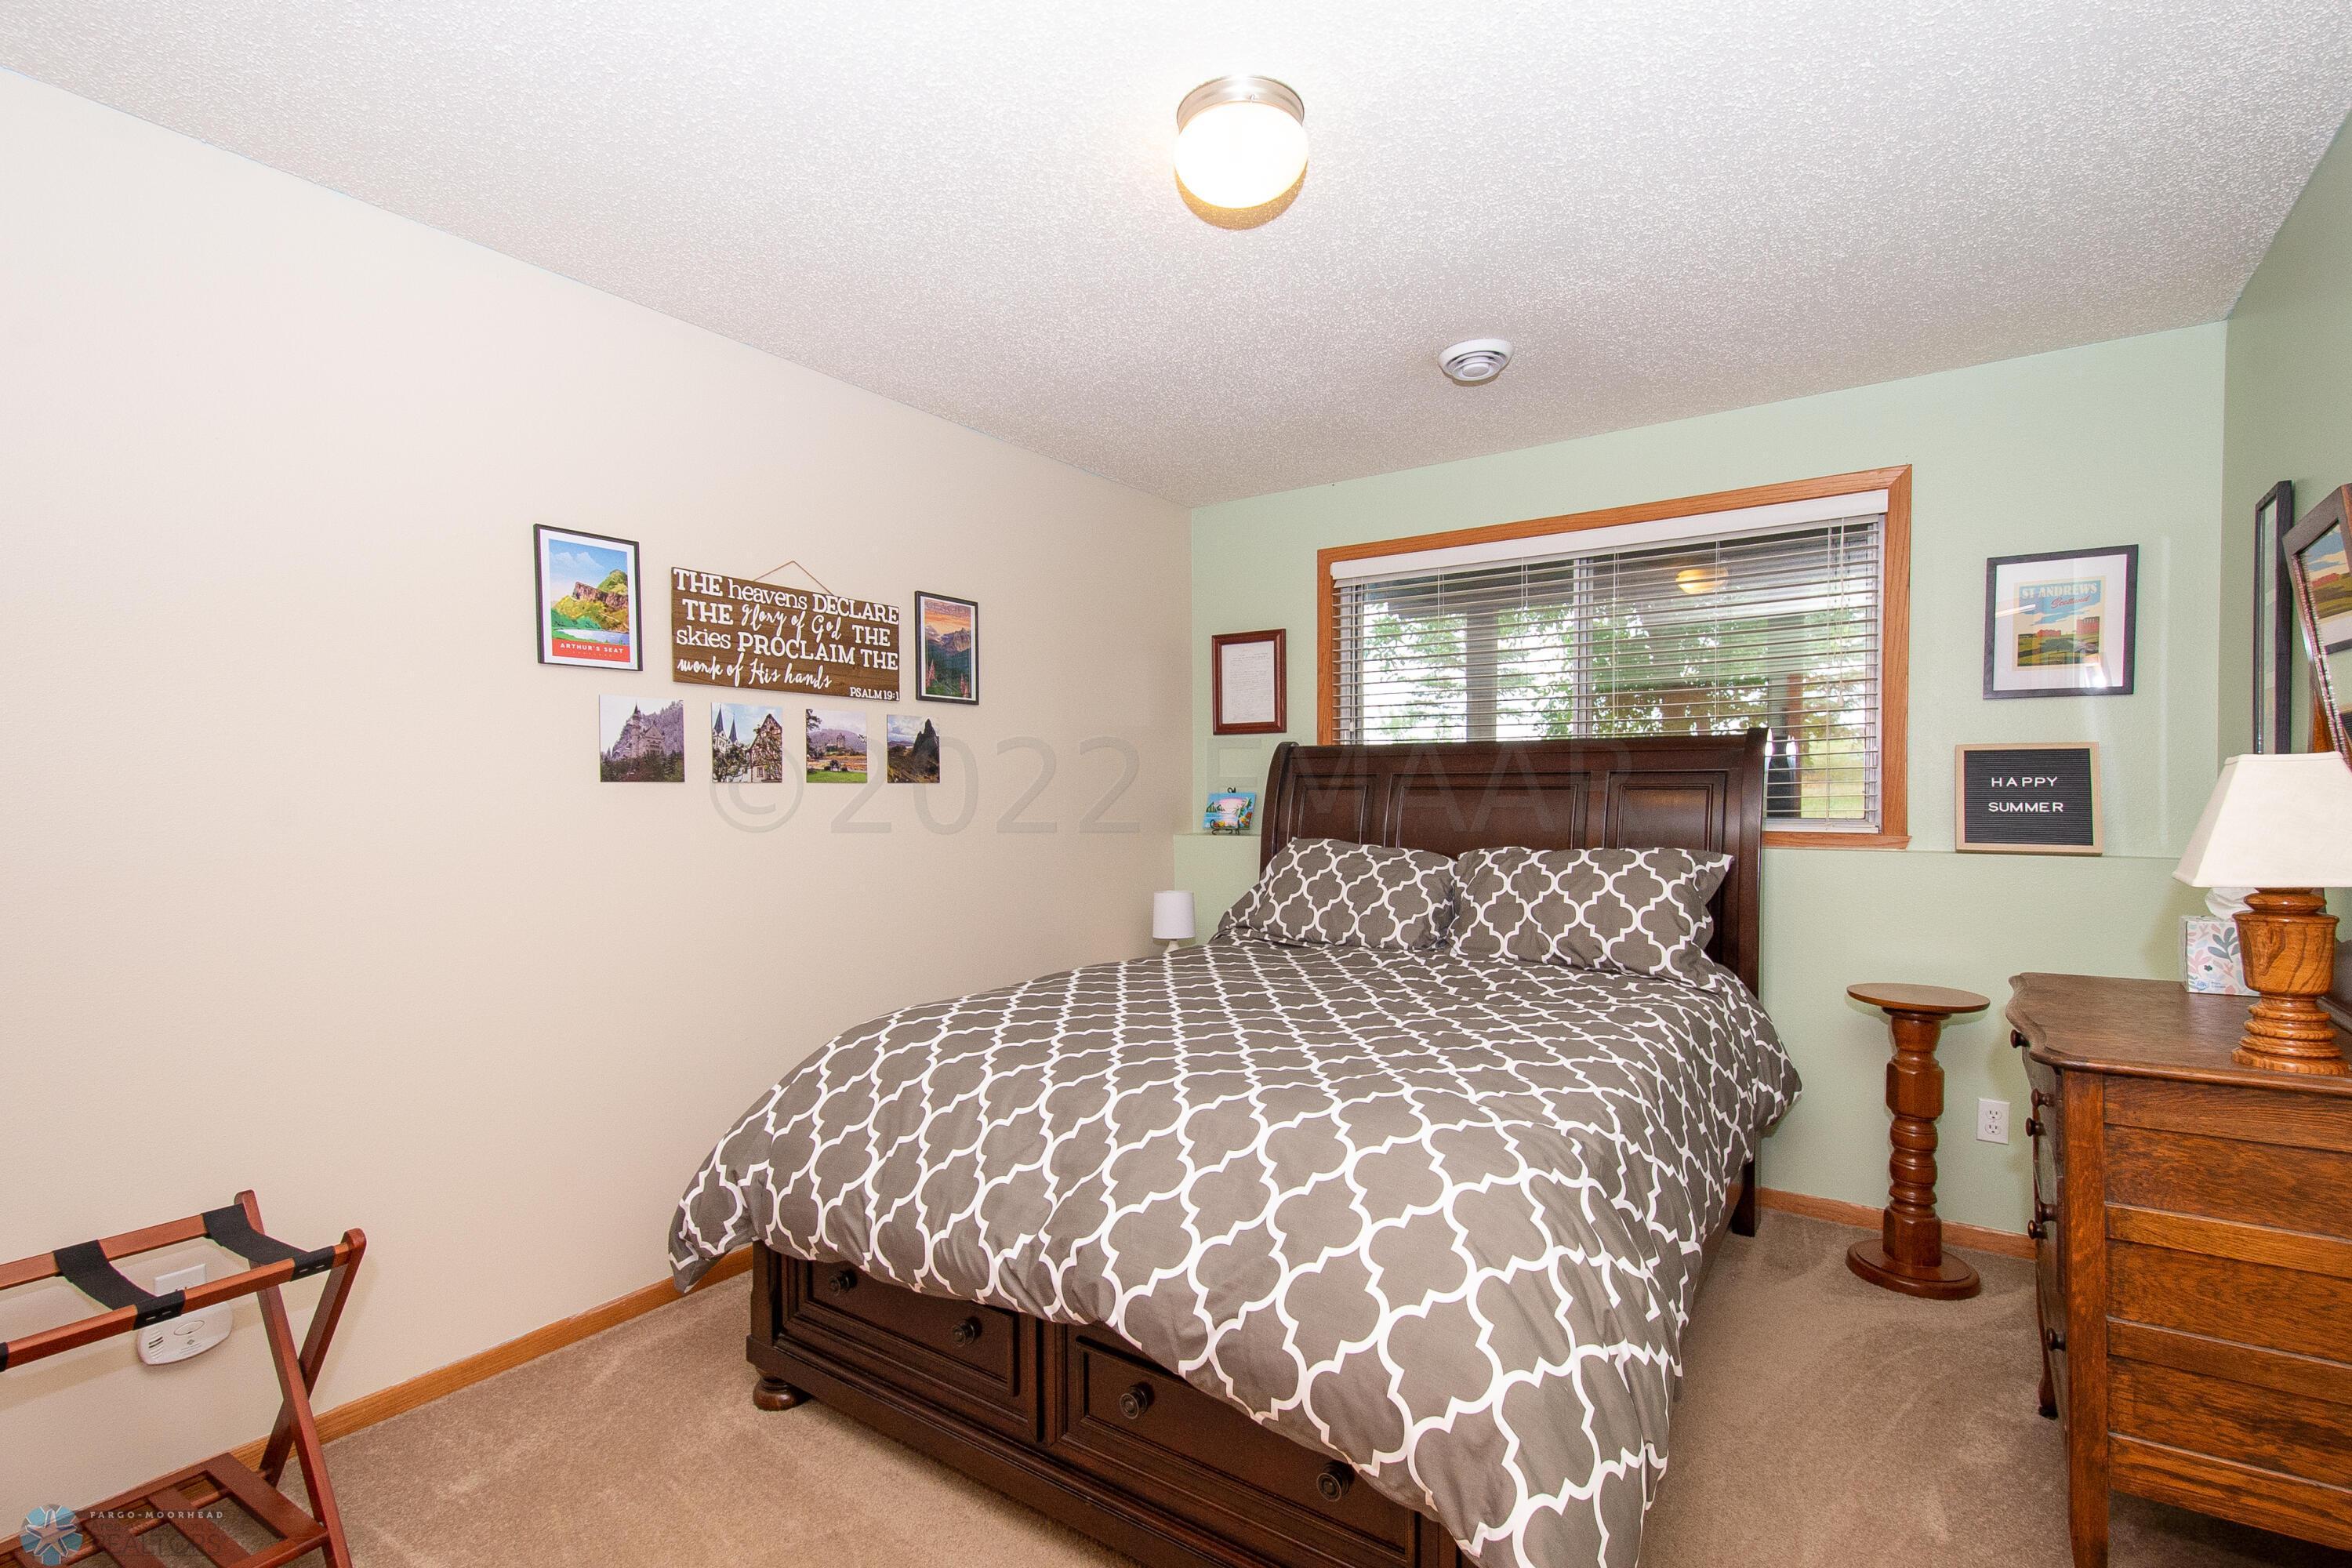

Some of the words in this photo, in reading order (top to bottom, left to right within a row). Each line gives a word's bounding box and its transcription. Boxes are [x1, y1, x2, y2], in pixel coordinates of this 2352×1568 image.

[673, 568, 723, 597] THE
[728, 579, 808, 610] heavens
[812, 593, 899, 625] DECLARE
[2038, 583, 2097, 598] ANDREWS
[682, 598, 734, 626] THE
[790, 611, 806, 648] of
[811, 615, 842, 643] God
[851, 624, 891, 647] THE
[560, 643, 601, 652] ARTHUR'S
[676, 625, 731, 650] skies
[737, 631, 856, 666] PROCLAIM
[860, 648, 899, 671] THE
[677, 655, 724, 681] work
[726, 652, 744, 687] of
[748, 658, 781, 685] His
[784, 662, 833, 690] hands
[849, 687, 883, 700] PSALM
[884, 690, 900, 701] 19:1
[1991, 776, 2058, 788] HAPPY
[1988, 801, 2064, 813] SUMMER
